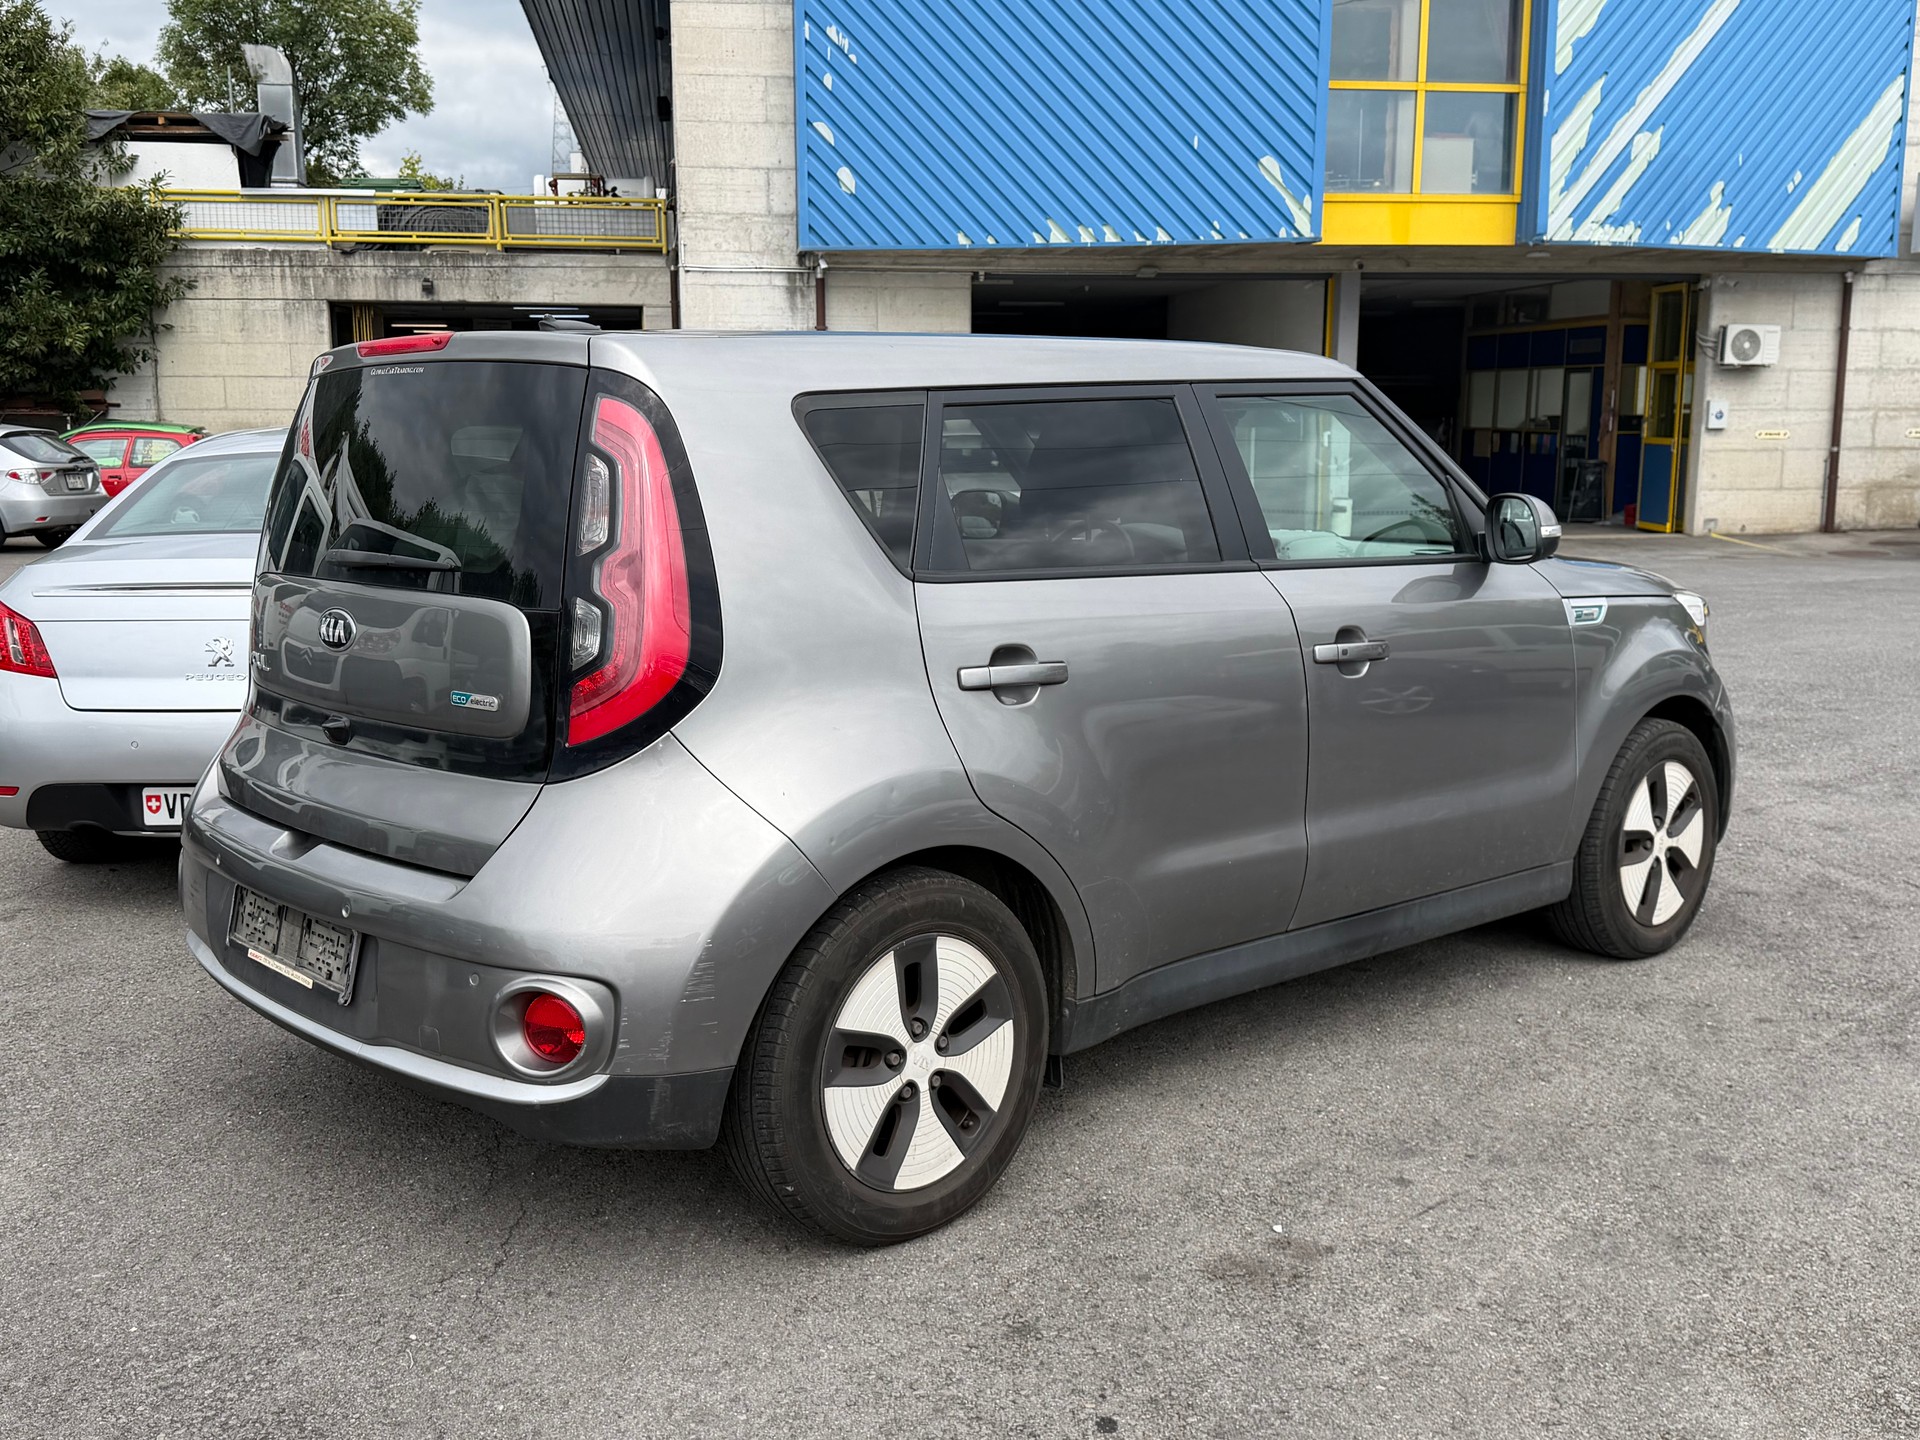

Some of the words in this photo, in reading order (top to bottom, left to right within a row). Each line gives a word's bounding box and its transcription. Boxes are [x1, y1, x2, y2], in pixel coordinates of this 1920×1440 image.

[320, 617, 347, 644] KIA
[185, 673, 248, 681] PEUGEO
[452, 694, 467, 704] ECO
[470, 697, 495, 708] electric
